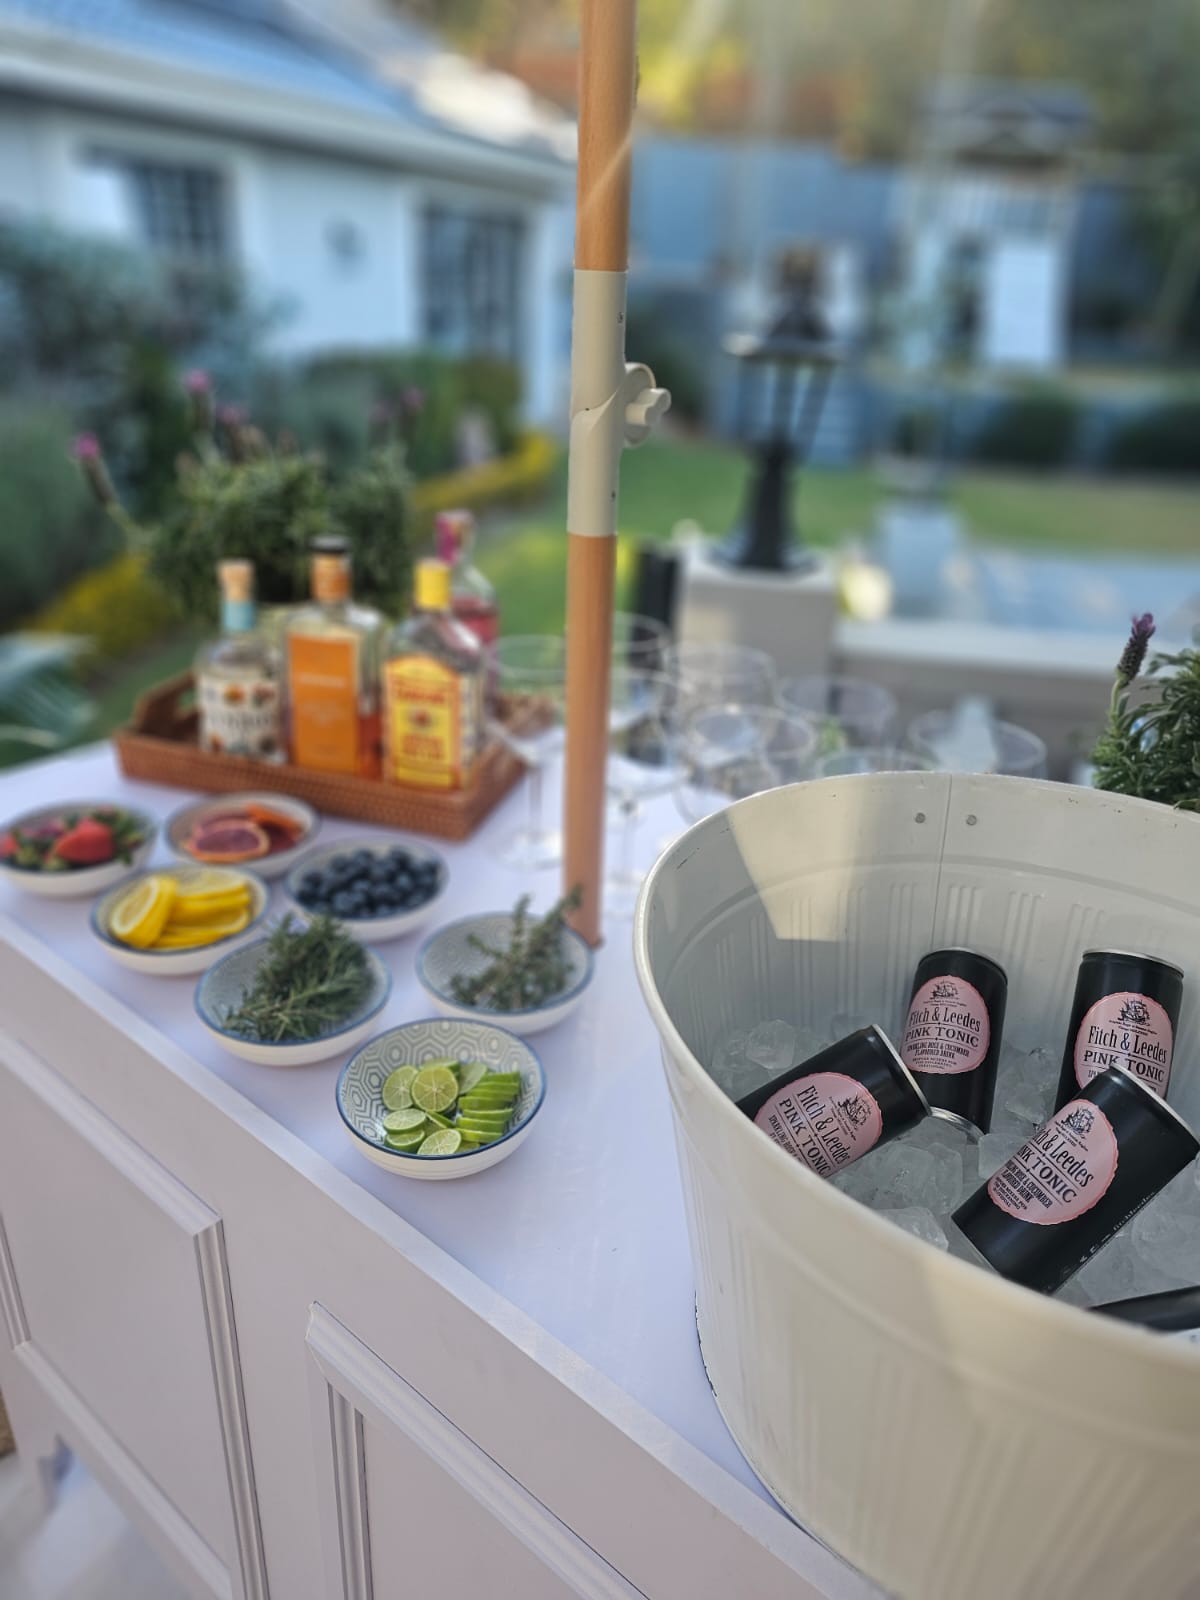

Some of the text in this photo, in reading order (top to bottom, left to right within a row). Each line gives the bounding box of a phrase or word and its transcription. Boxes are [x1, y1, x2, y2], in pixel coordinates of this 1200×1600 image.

[909, 1006, 980, 1032] Fitch & Leedes
[905, 1026, 979, 1047] PINK TONIC
[1088, 1025, 1117, 1048] Fitch
[1120, 1032, 1130, 1051] &
[1133, 1034, 1167, 1064] Leedes
[1083, 1050, 1165, 1082] PINK TONIC
[797, 1085, 826, 1120] Fitch
[815, 1117, 833, 1132] &
[768, 1114, 788, 1143] SPARKLING
[779, 1098, 831, 1176] PINK TONIC
[1042, 1134, 1058, 1151] &
[1051, 1141, 1094, 1187] Leedes
[1017, 1185, 1034, 1203] DRINK
[1026, 1181, 1053, 1209] CUCUMBER
[1032, 1157, 1077, 1203] TONIC
